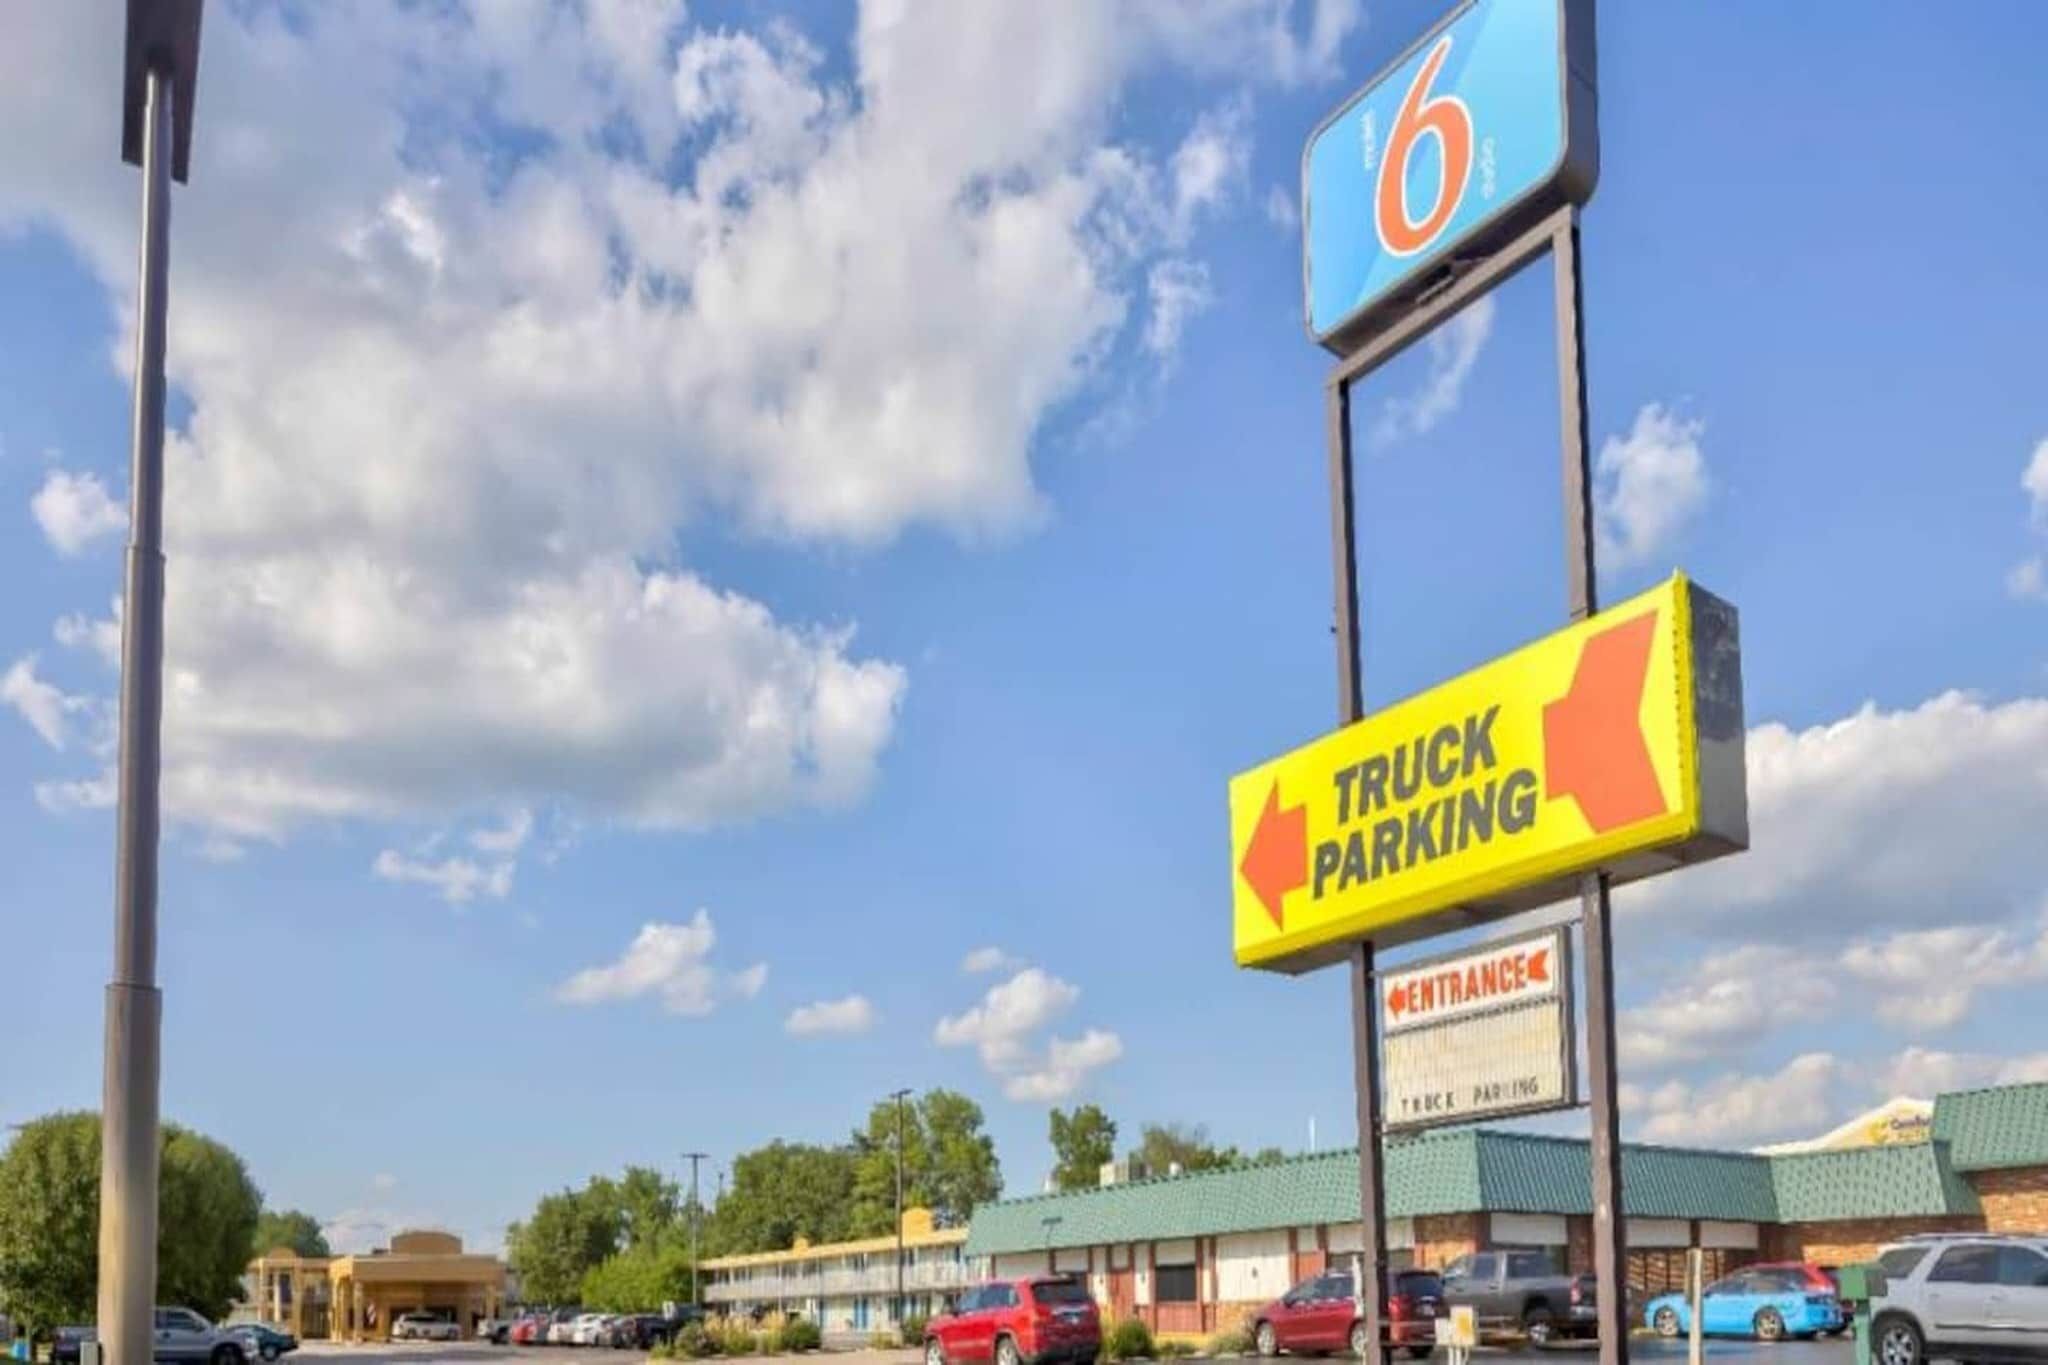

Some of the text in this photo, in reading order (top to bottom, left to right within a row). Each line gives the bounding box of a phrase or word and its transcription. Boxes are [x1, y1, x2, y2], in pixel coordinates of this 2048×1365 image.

[1374, 34, 1473, 257] 6
[1334, 704, 1501, 824] TRUCK
[1312, 768, 1537, 900] PARKING
[1407, 953, 1526, 1013] ENTRANCE
